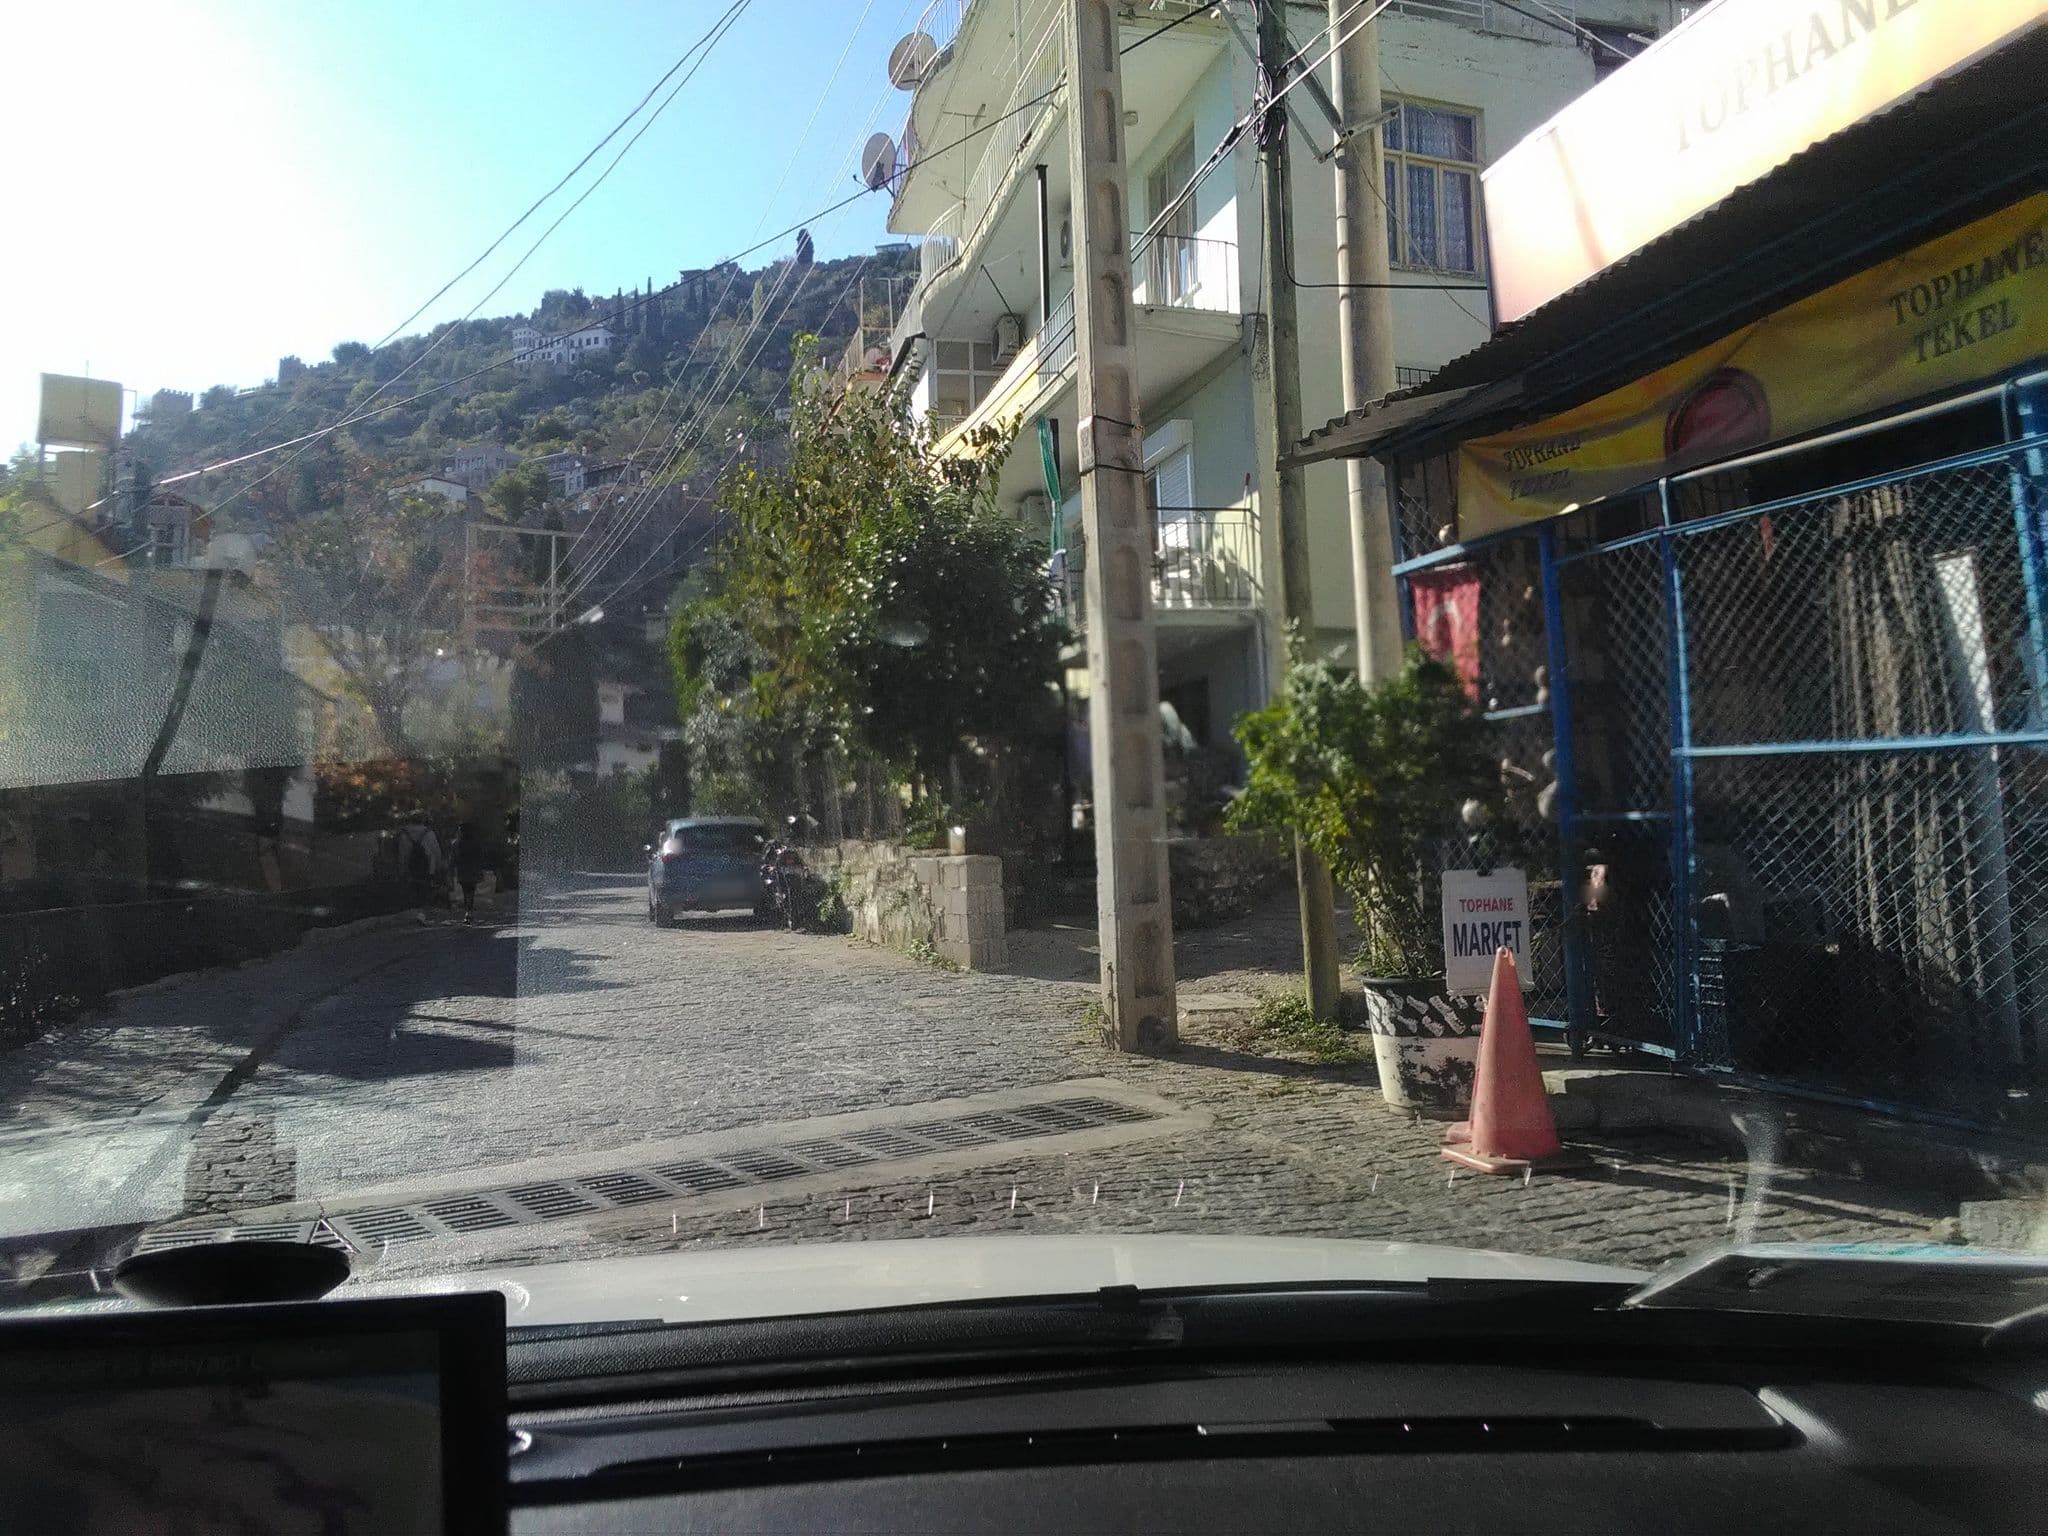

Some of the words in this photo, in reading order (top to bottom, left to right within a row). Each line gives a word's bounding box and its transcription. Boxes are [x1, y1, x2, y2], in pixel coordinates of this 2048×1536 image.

[1887, 228, 2048, 325] TOPHANE
[1914, 298, 2017, 362] TEKEL
[1459, 897, 1514, 913] TOPHANE
[1453, 920, 1521, 957] MARKET
